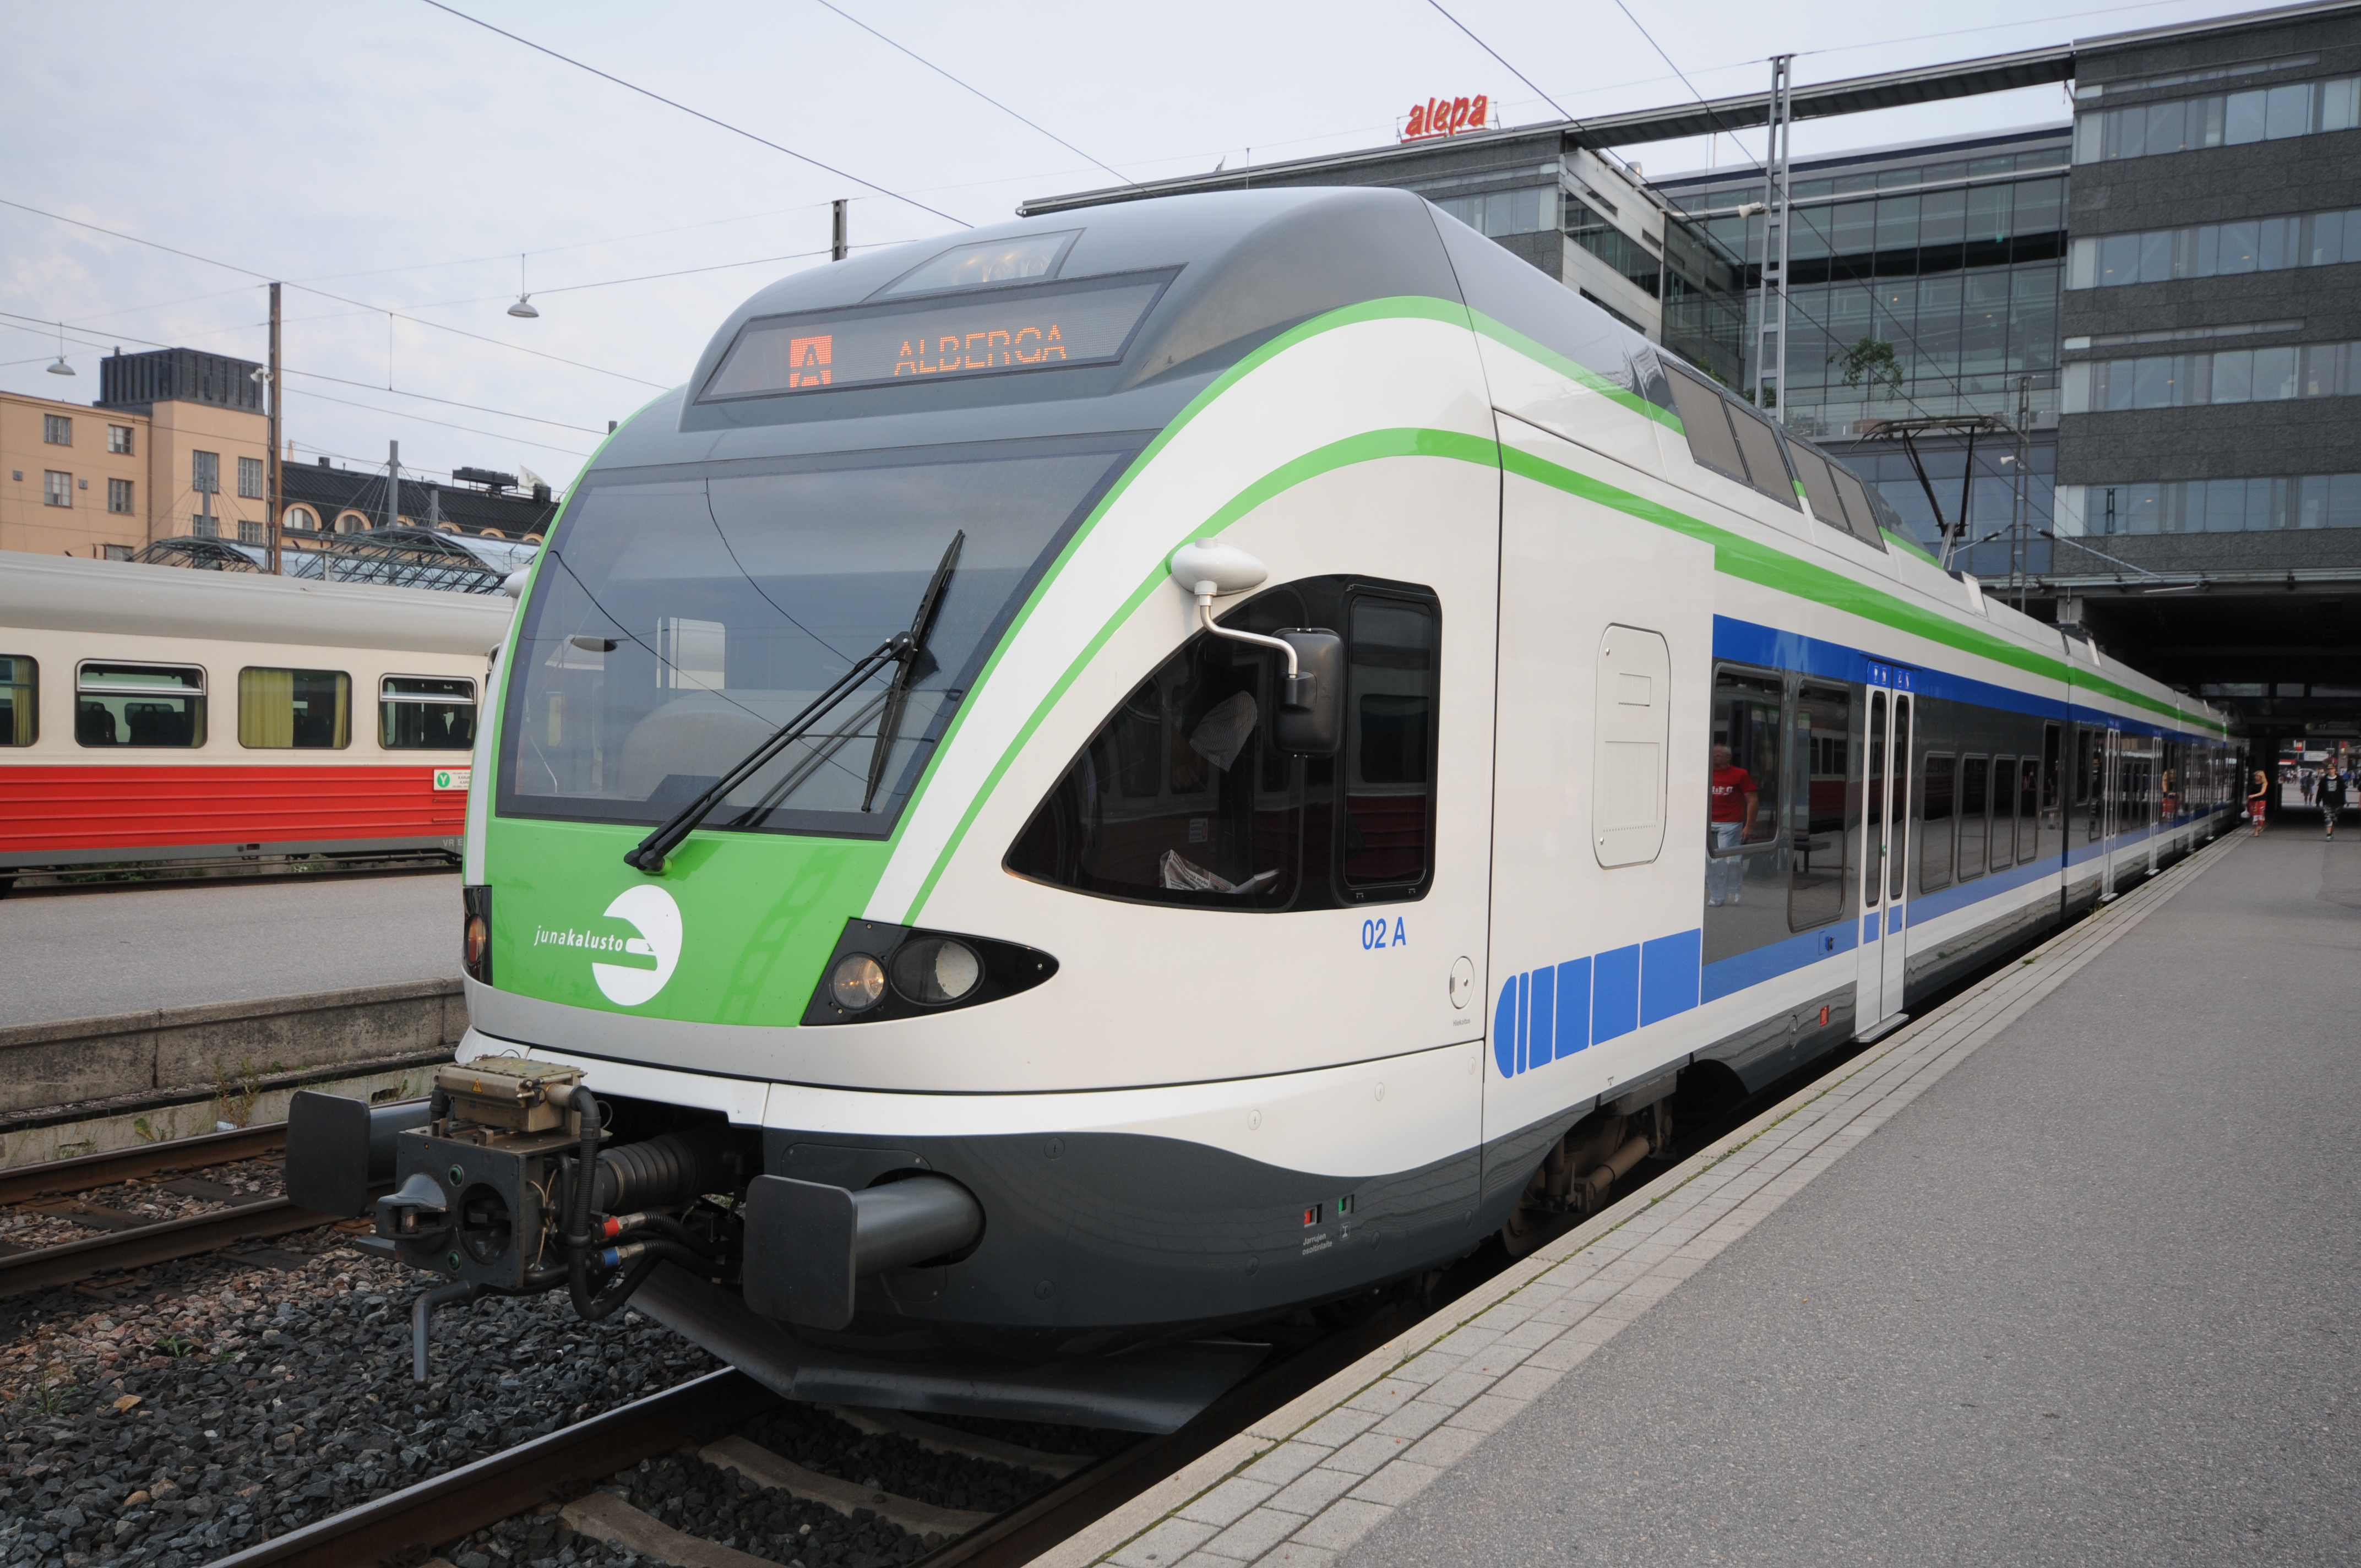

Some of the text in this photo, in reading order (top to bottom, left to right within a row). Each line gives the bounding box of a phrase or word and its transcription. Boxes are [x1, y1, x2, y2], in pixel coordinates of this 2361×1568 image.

[1405, 94, 1489, 137] alepa
[795, 340, 827, 388] A
[439, 774, 448, 786] Y
[443, 839, 454, 847] VR
[534, 925, 624, 952] junakalusto
[1362, 916, 1406, 950] 02 A
[1452, 1018, 1471, 1027] Hiekoitus
[1303, 1233, 1326, 1246] Jarrujen
[1302, 1240, 1332, 1256] osoitinlaite
